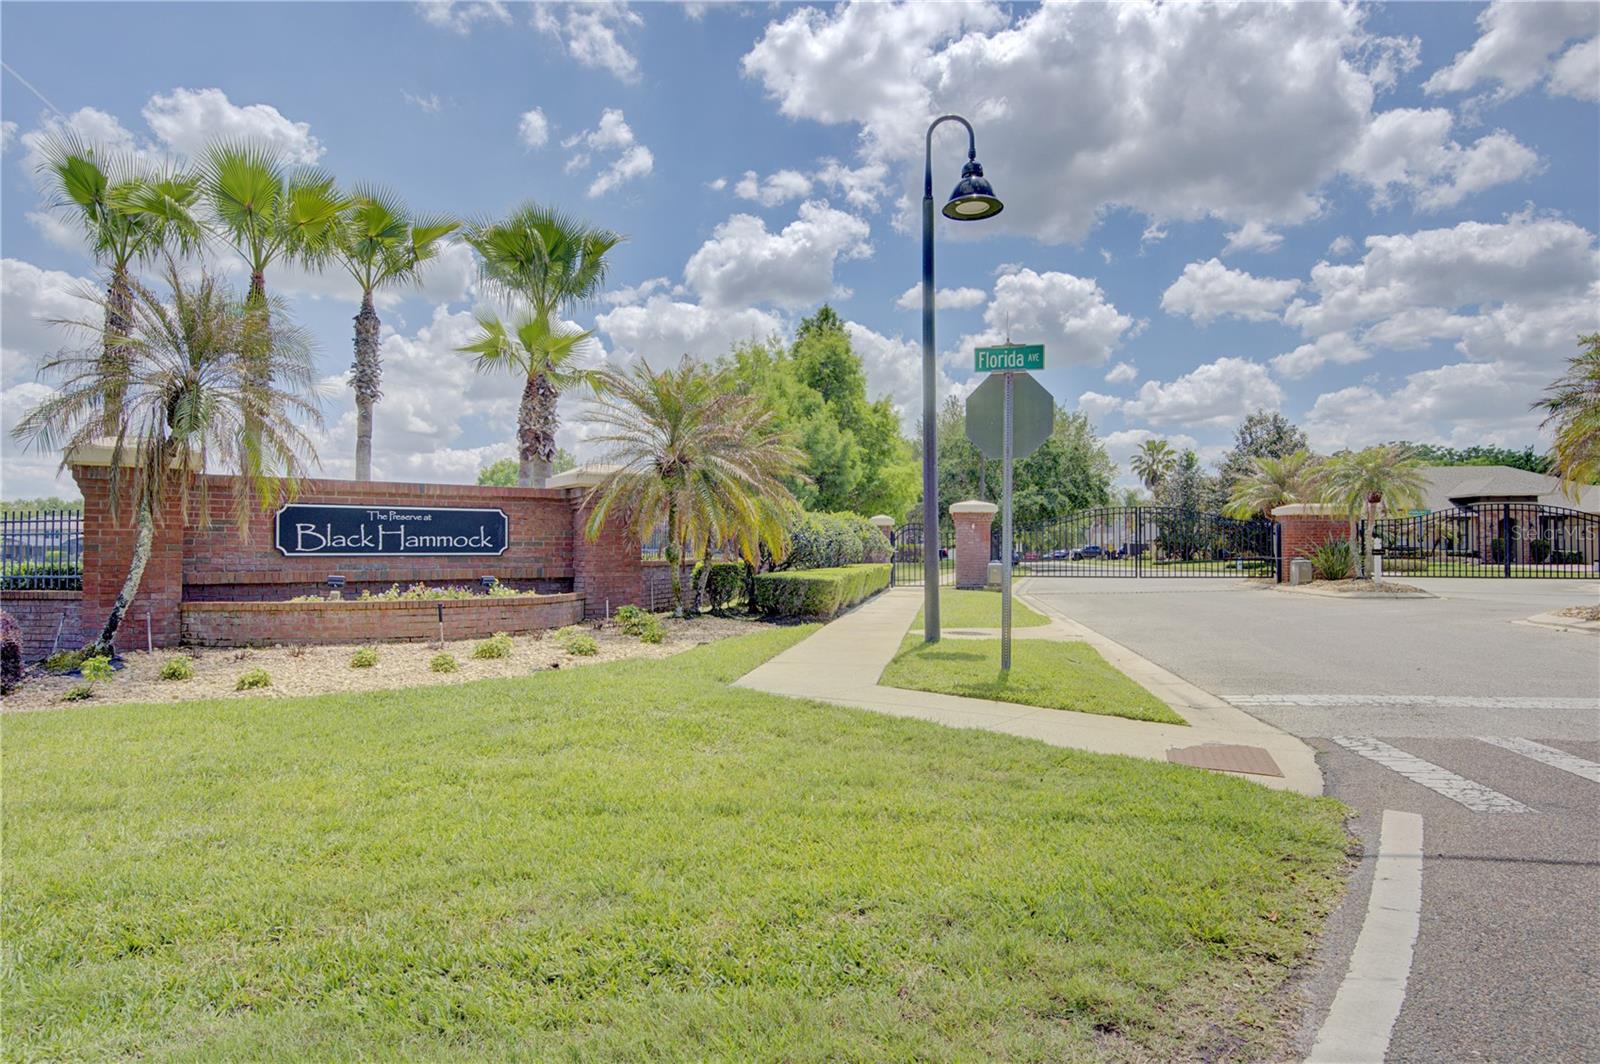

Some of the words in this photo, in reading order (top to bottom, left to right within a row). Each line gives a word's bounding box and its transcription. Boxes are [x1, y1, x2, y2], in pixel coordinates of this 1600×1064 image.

[979, 350, 1025, 368] Florida
[1028, 352, 1041, 362] AVE
[366, 510, 388, 521] The
[389, 510, 423, 521] Preserve
[295, 523, 375, 552] Black
[378, 524, 494, 551] Hammock
